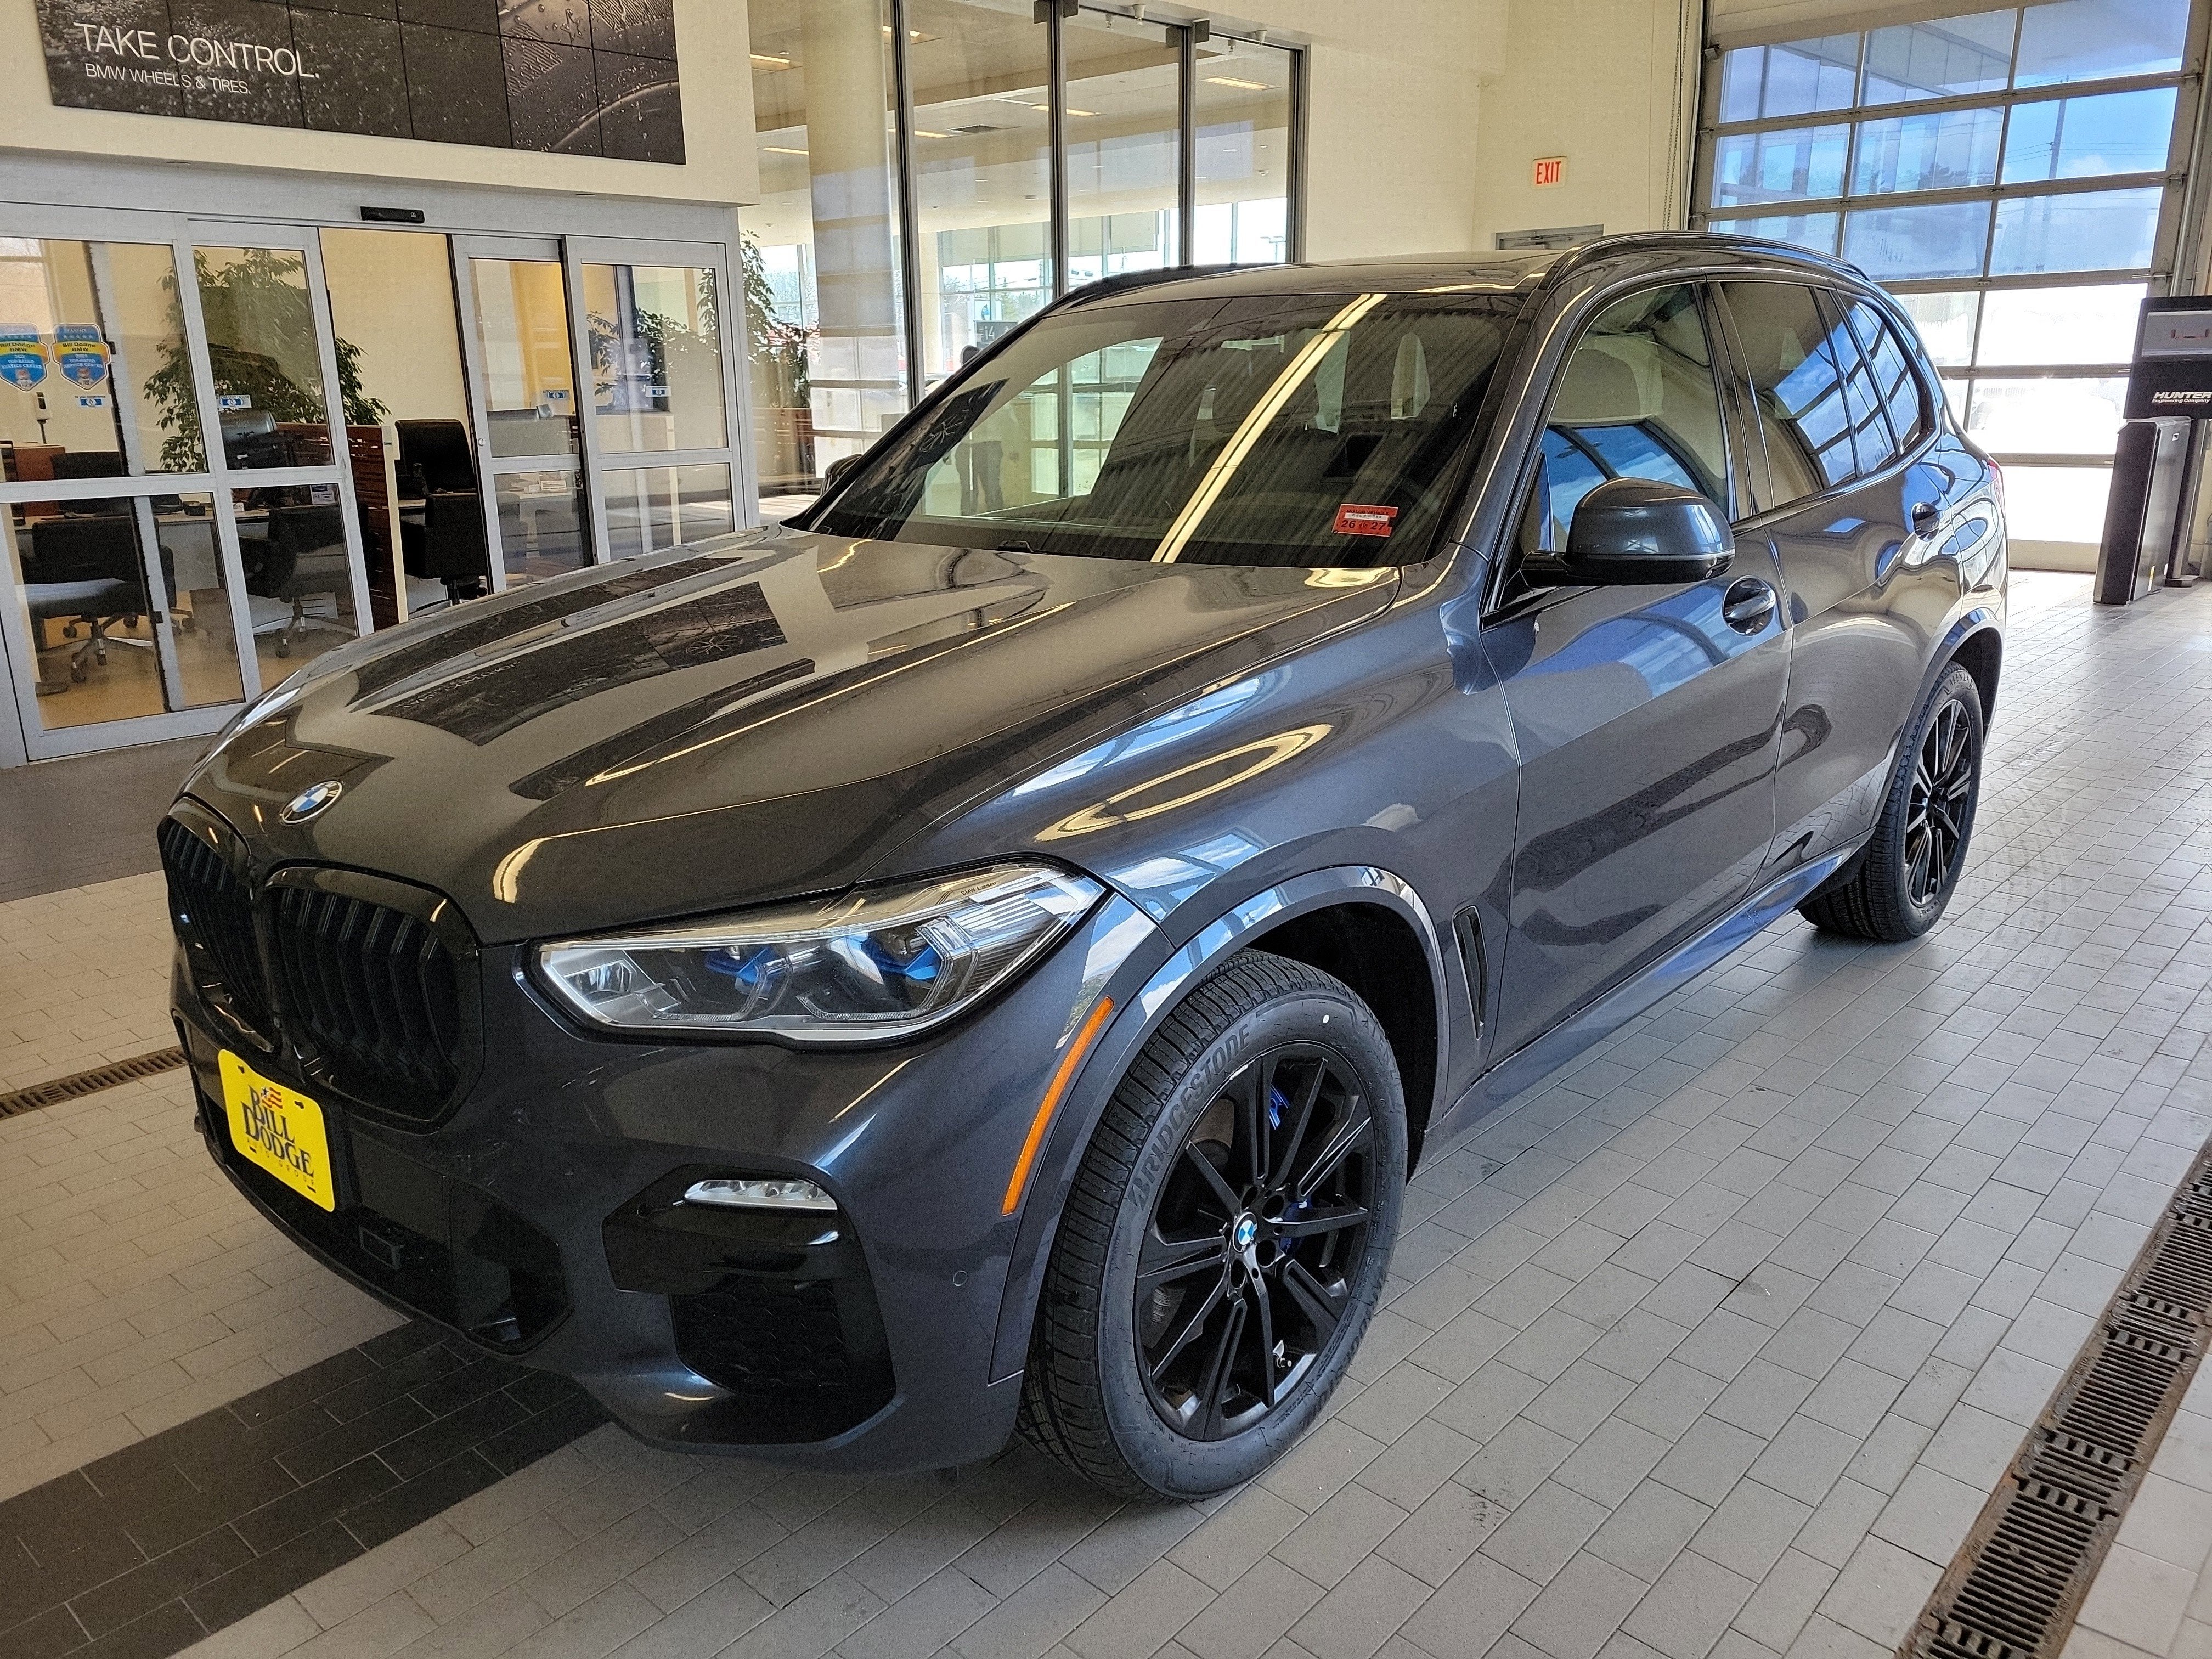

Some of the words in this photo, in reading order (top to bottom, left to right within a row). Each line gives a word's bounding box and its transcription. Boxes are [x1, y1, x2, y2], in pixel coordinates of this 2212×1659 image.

[74, 22, 160, 59] TAKE
[168, 35, 320, 78] CONTROL.
[85, 63, 126, 80] BMW
[128, 67, 191, 88] WHEELS
[195, 76, 207, 90] &
[210, 77, 252, 95] TIRES.
[1537, 161, 1561, 184] EXIT
[2154, 391, 2212, 399] HUNTER
[1340, 520, 1356, 528] 26
[1369, 521, 1387, 531] 27
[977, 881, 998, 891] Laser
[249, 1085, 296, 1144] BILL
[1126, 1024, 1249, 1210] BRIDGESTONE
[240, 1101, 315, 1178] DODGE
